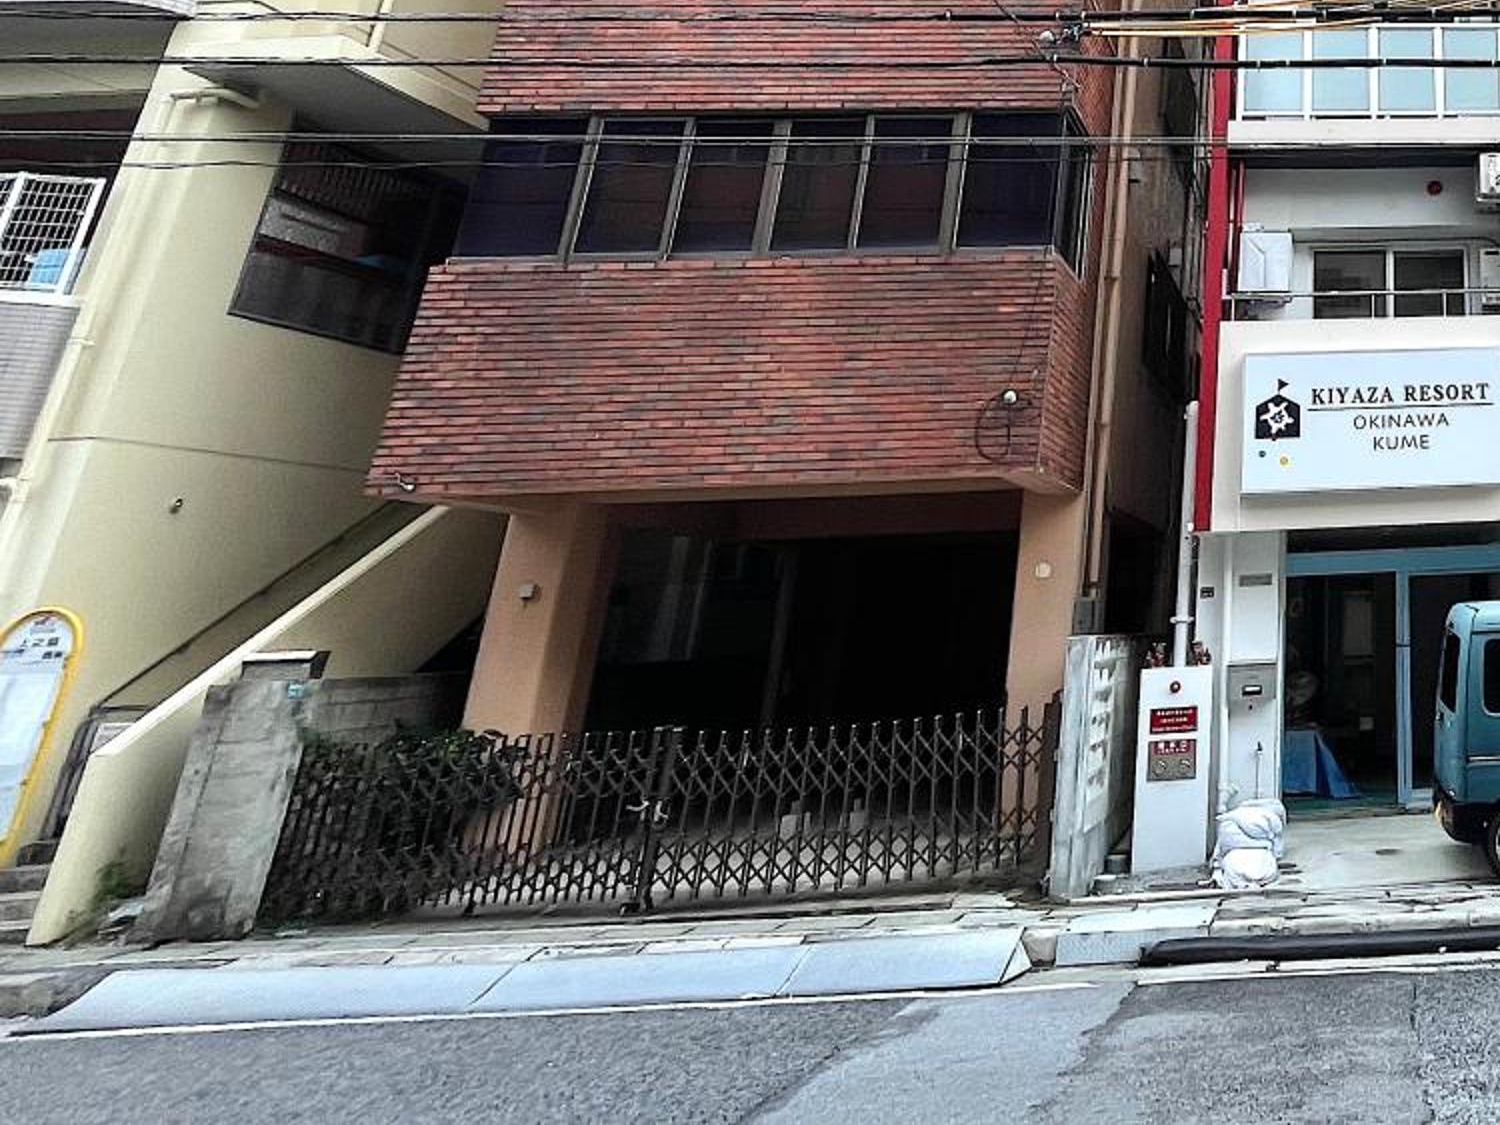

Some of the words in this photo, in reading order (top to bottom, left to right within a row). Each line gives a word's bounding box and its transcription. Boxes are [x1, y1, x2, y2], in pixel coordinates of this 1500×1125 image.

[1311, 386, 1394, 405] KIYAZA
[1403, 382, 1489, 403] RESORT
[1353, 412, 1449, 430] OKINAWA
[1373, 434, 1430, 452] KUME
